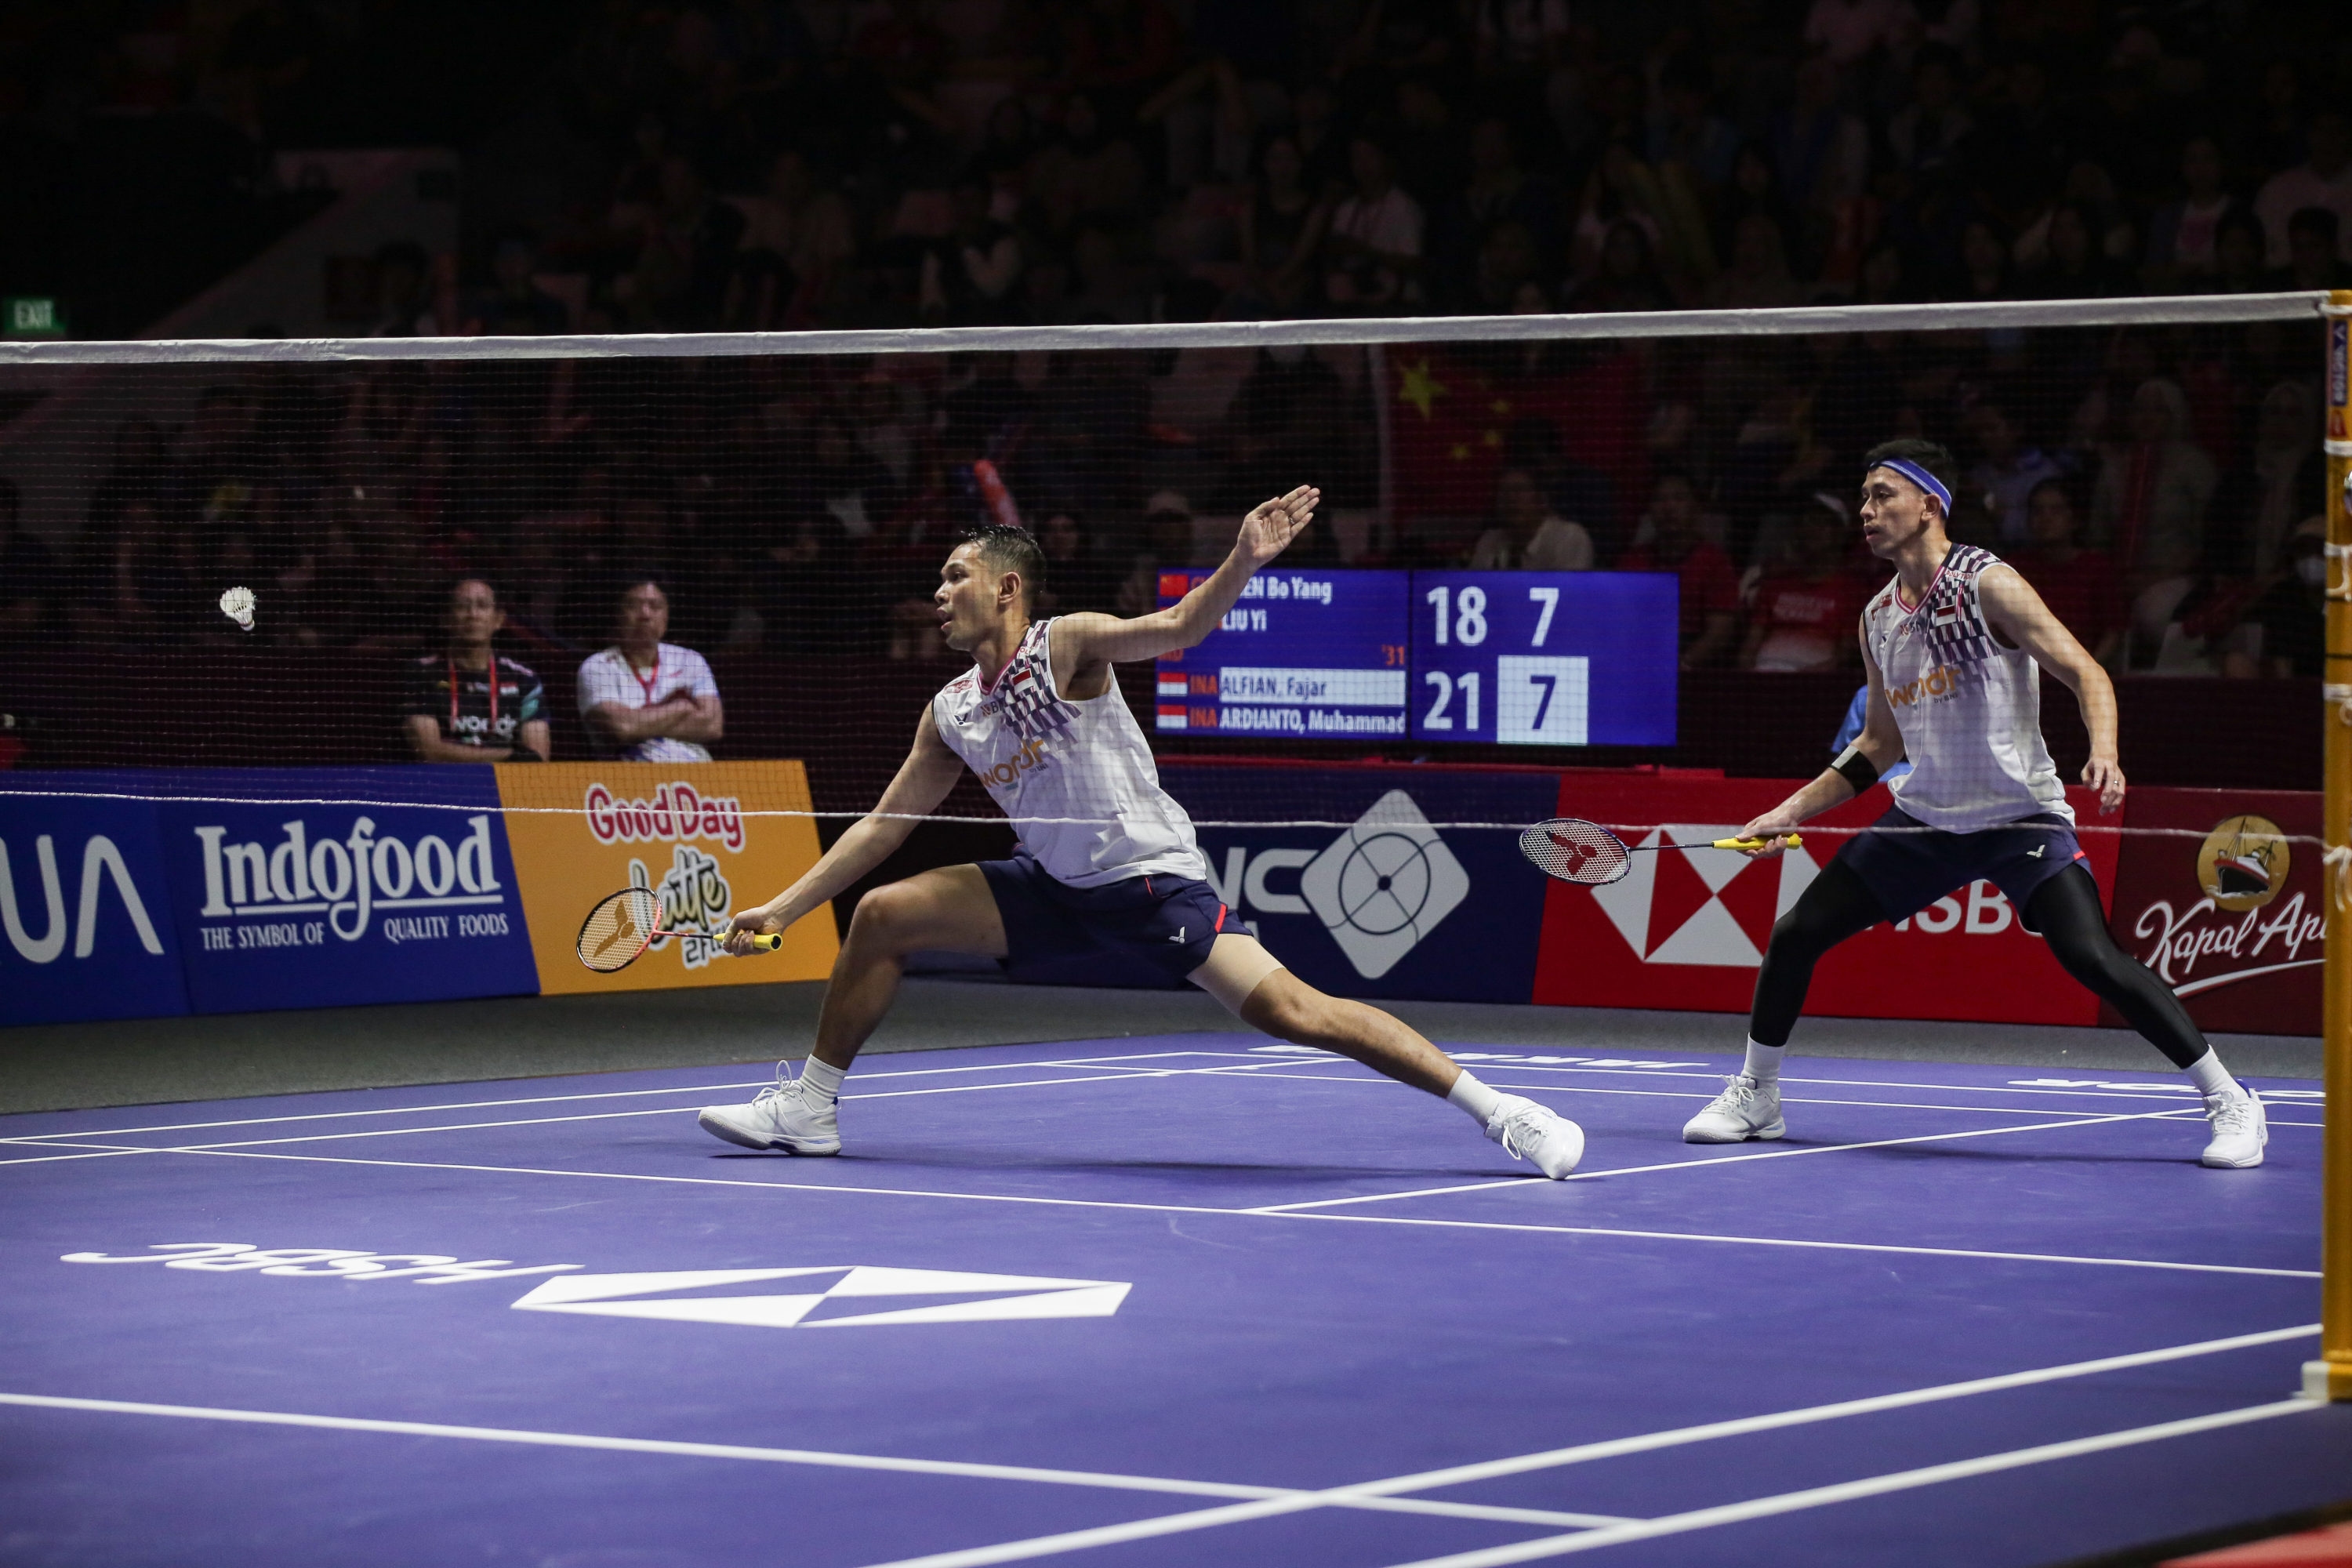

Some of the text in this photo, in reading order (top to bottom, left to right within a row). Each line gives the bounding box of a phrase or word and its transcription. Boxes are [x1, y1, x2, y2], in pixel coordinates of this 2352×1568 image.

[15, 299, 53, 328] EXIT
[1240, 576, 1332, 604] EN Bo Yang
[1426, 586, 1487, 646] 18
[1530, 587, 1559, 647] 7
[1221, 609, 1267, 632] LIU Yi
[1189, 675, 1327, 700] INA ALFIAN, Fajar
[1423, 671, 1480, 731] 21
[1530, 675, 1556, 730] 7
[1189, 707, 1216, 728] INA
[1219, 707, 1306, 734] ARDIANTO,
[586, 784, 745, 850] Good Day
[194, 815, 502, 940] Indofood
[1198, 846, 1319, 914] NC
[201, 913, 510, 950] THE SYMBOL OF QUALITY FOODS
[1863, 878, 2043, 937] SB
[2134, 899, 2258, 985] Kapal
[60, 1243, 586, 1284] HSBC
